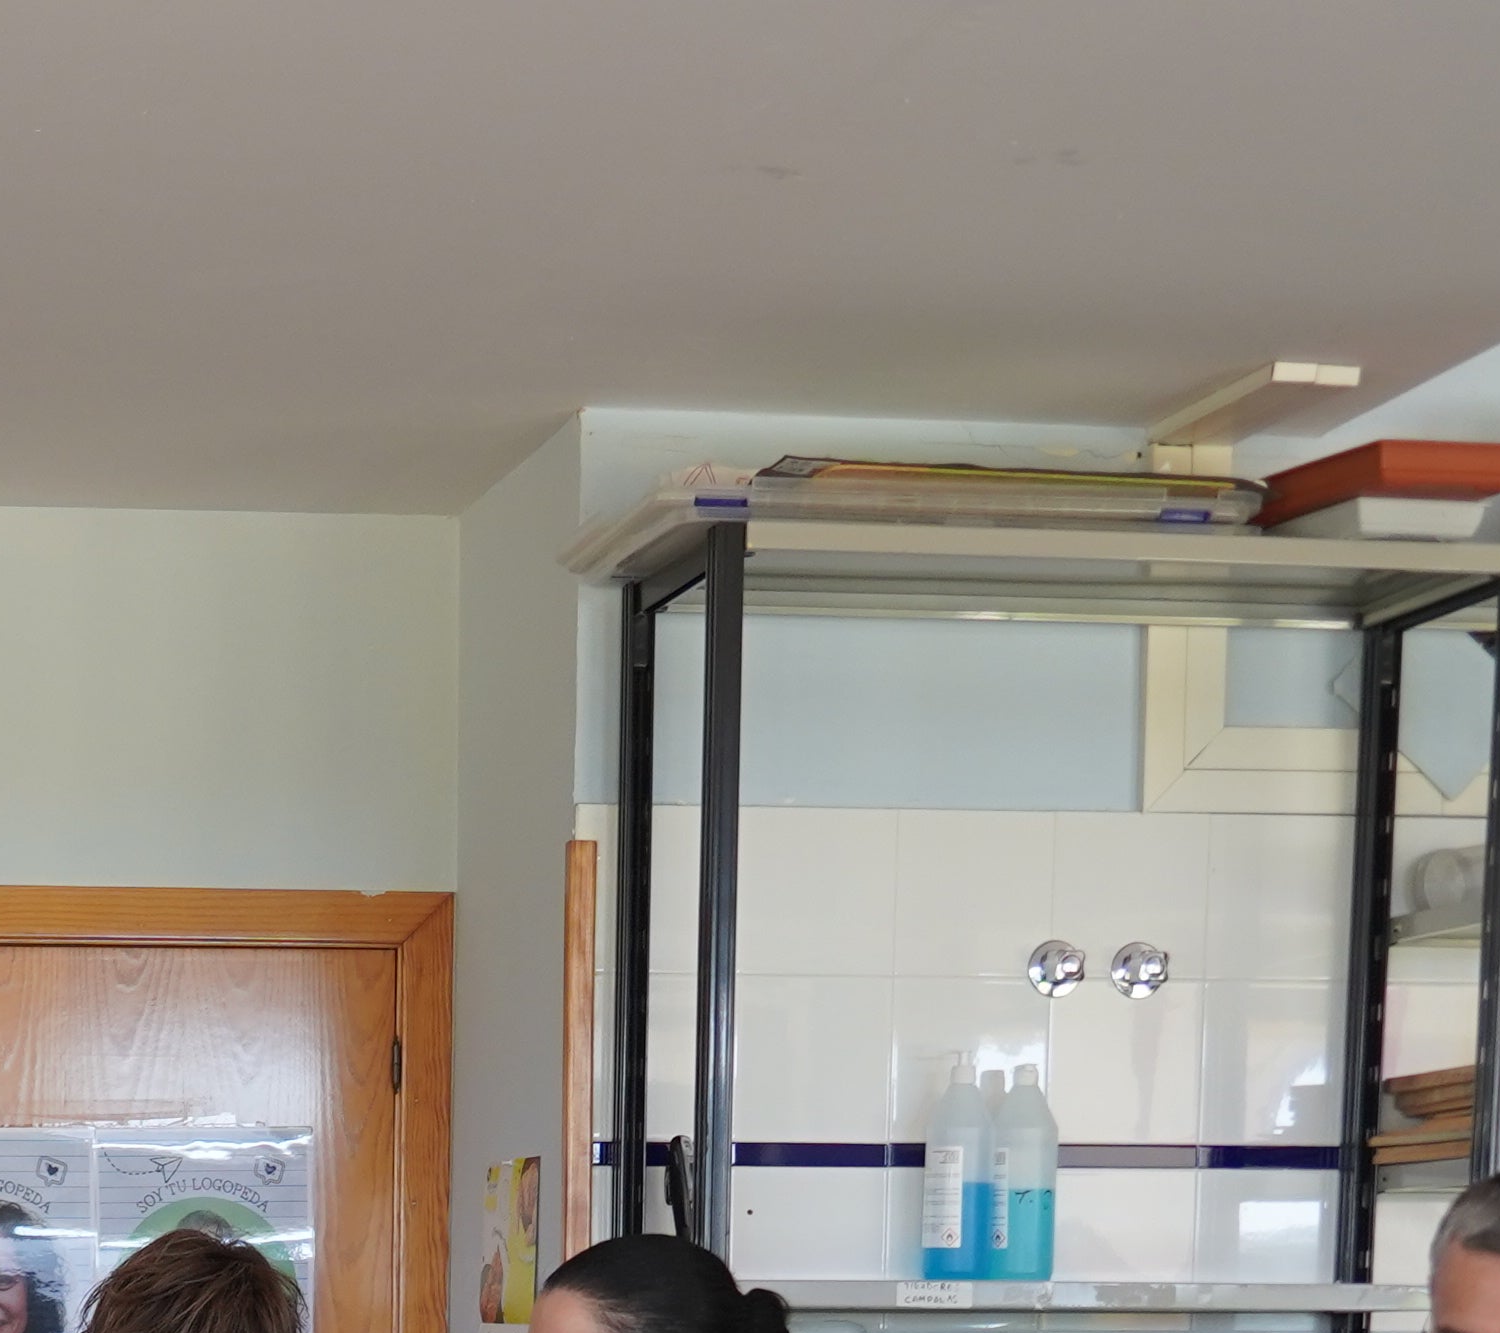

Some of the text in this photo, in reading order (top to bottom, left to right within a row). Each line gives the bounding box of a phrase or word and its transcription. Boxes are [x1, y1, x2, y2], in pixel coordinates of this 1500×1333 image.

[136, 1177, 272, 1214] SOY TU LOGOPEDA
